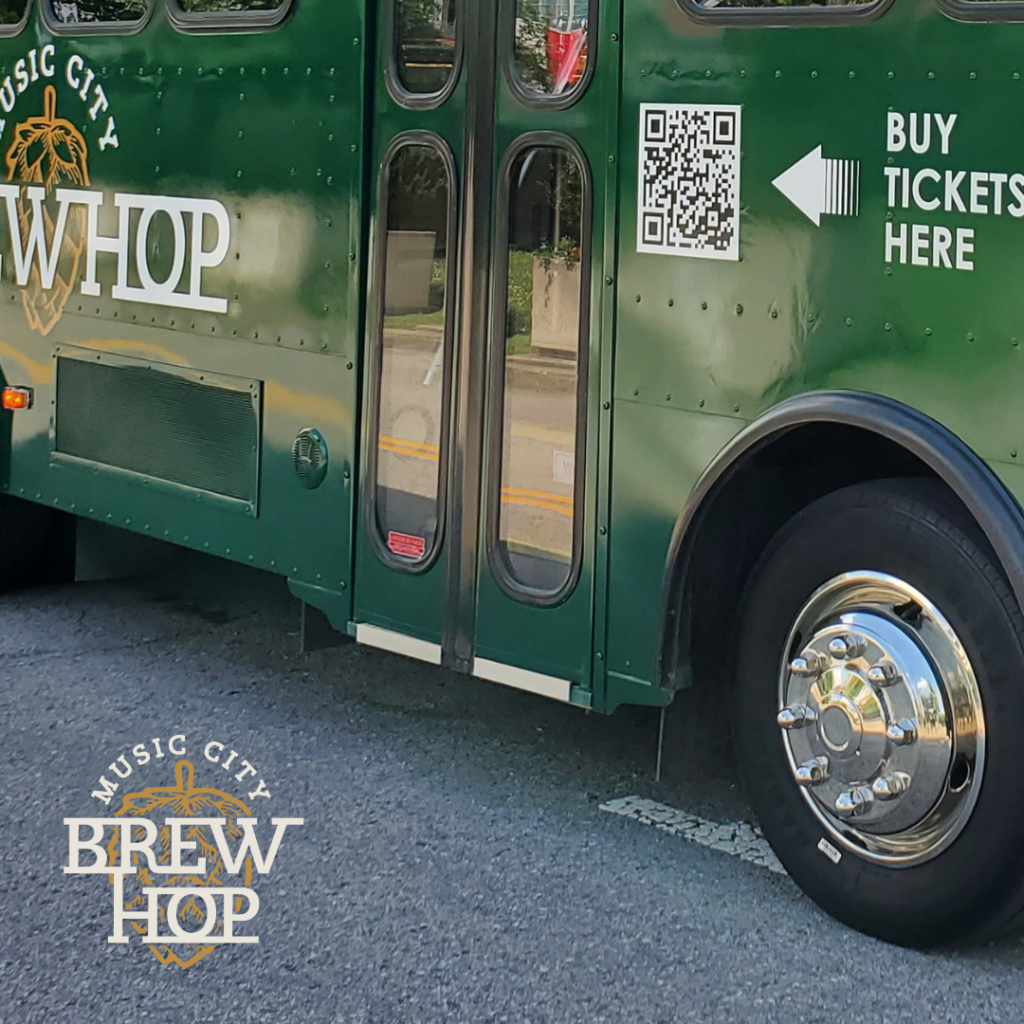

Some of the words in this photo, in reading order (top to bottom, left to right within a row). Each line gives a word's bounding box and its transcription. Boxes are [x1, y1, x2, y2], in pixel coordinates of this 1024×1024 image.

[0, 44, 55, 140] USIC
[65, 54, 119, 151] CITY
[886, 111, 958, 155] BUY
[884, 222, 975, 271] HERE
